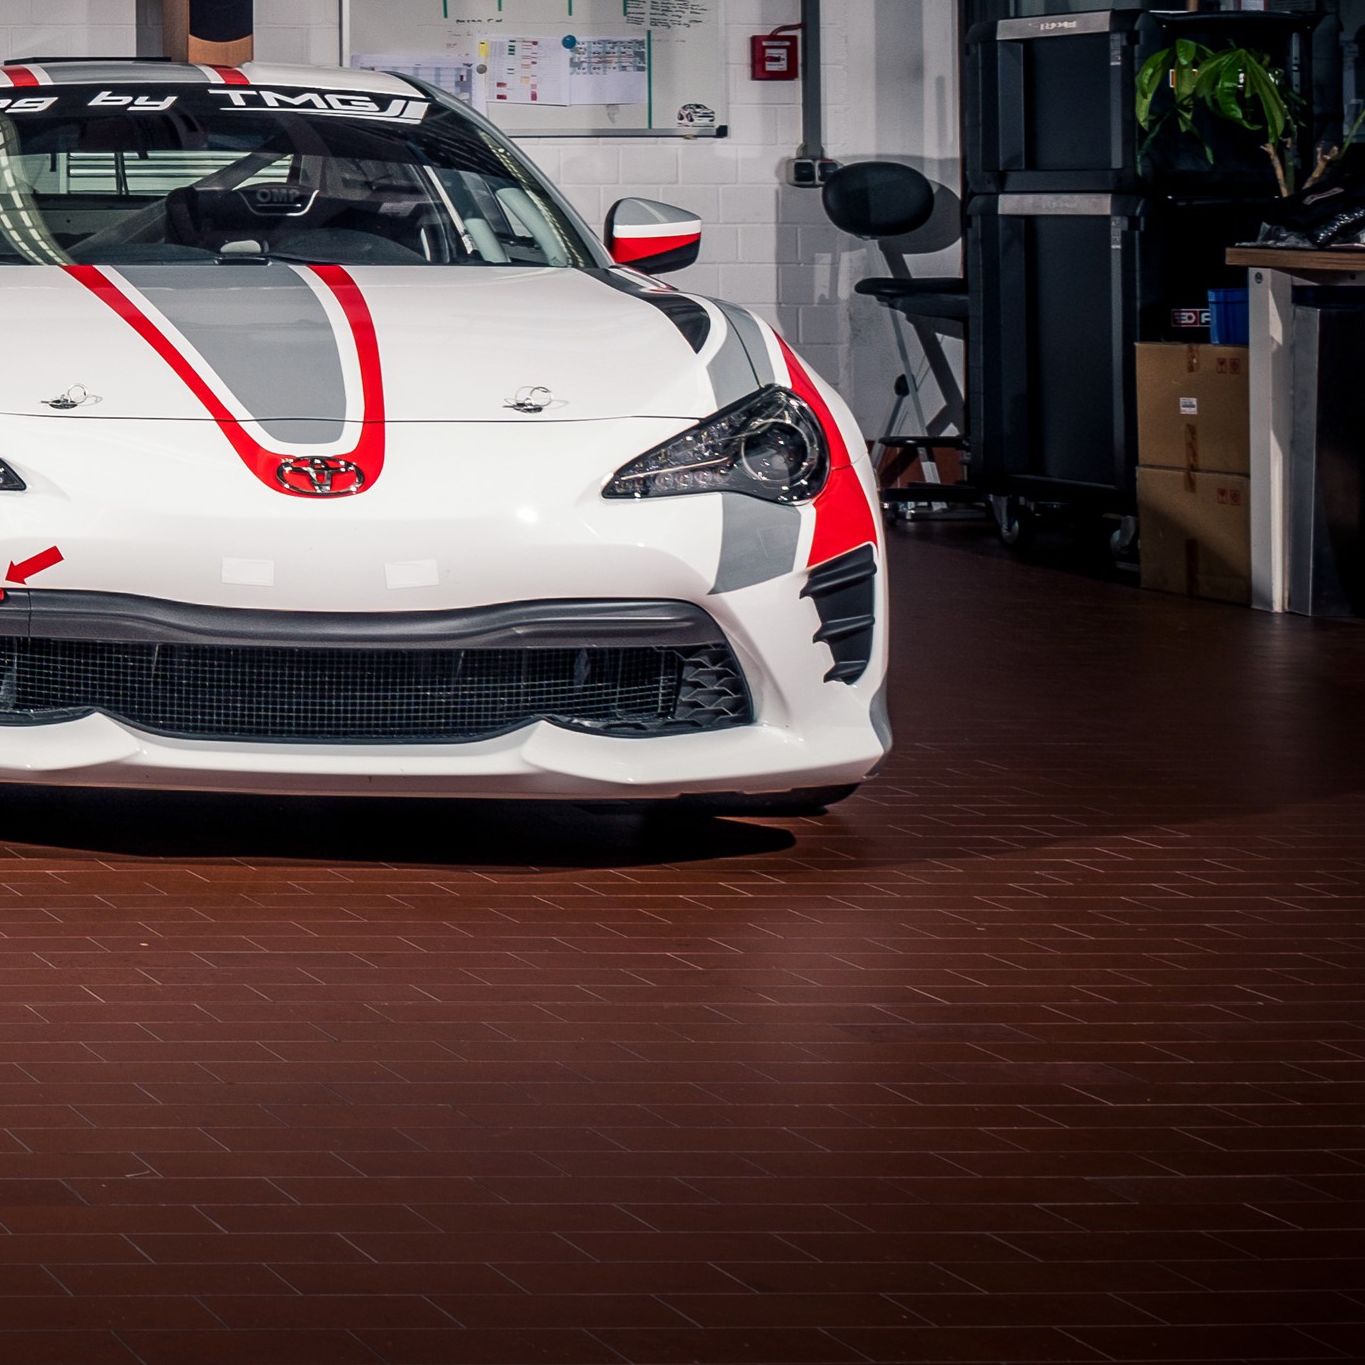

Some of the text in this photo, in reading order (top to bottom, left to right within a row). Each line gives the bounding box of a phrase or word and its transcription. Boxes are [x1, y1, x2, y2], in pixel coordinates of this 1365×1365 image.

[89, 91, 178, 112] by
[207, 88, 379, 113] TMG
[256, 188, 300, 203] OMP
